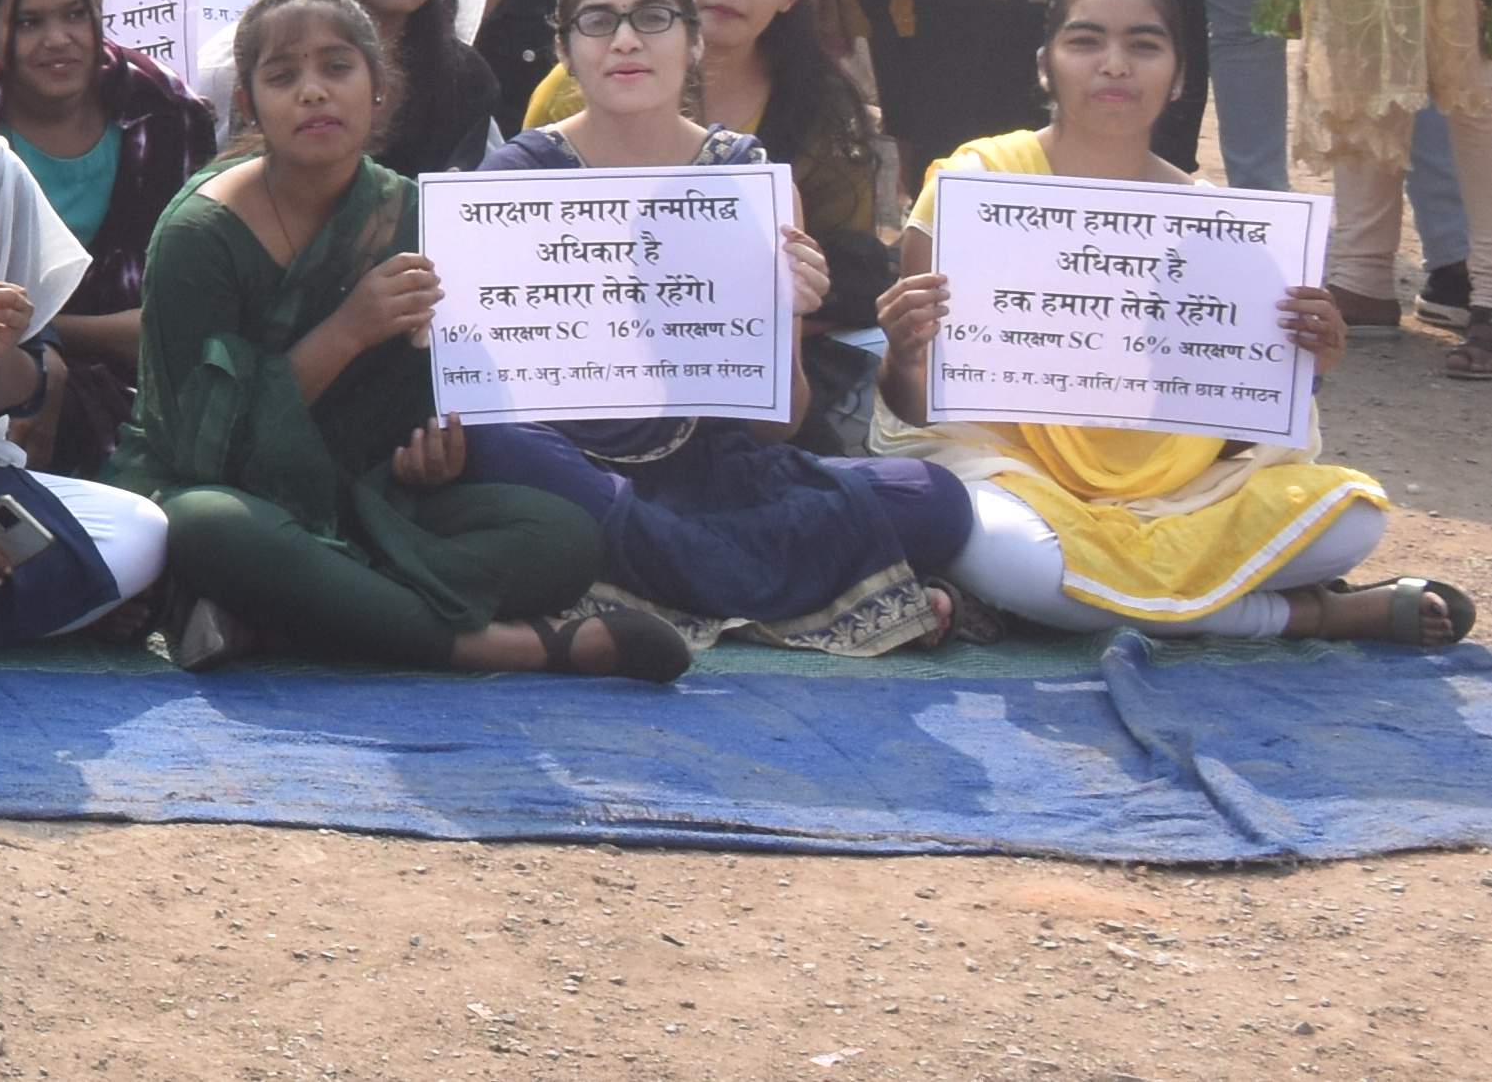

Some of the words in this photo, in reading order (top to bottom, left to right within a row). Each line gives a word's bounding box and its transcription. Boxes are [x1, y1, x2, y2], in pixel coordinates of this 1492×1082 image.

[977, 201, 1077, 234] आरक्षण
[1083, 210, 1156, 239] हमारा
[1163, 210, 1271, 245] जन्मसिद्ध
[1056, 245, 1162, 282] अधिकार
[1167, 248, 1187, 284] है
[993, 288, 1036, 314] हक
[1041, 291, 1114, 321] हमारा
[1120, 290, 1169, 322] लेके
